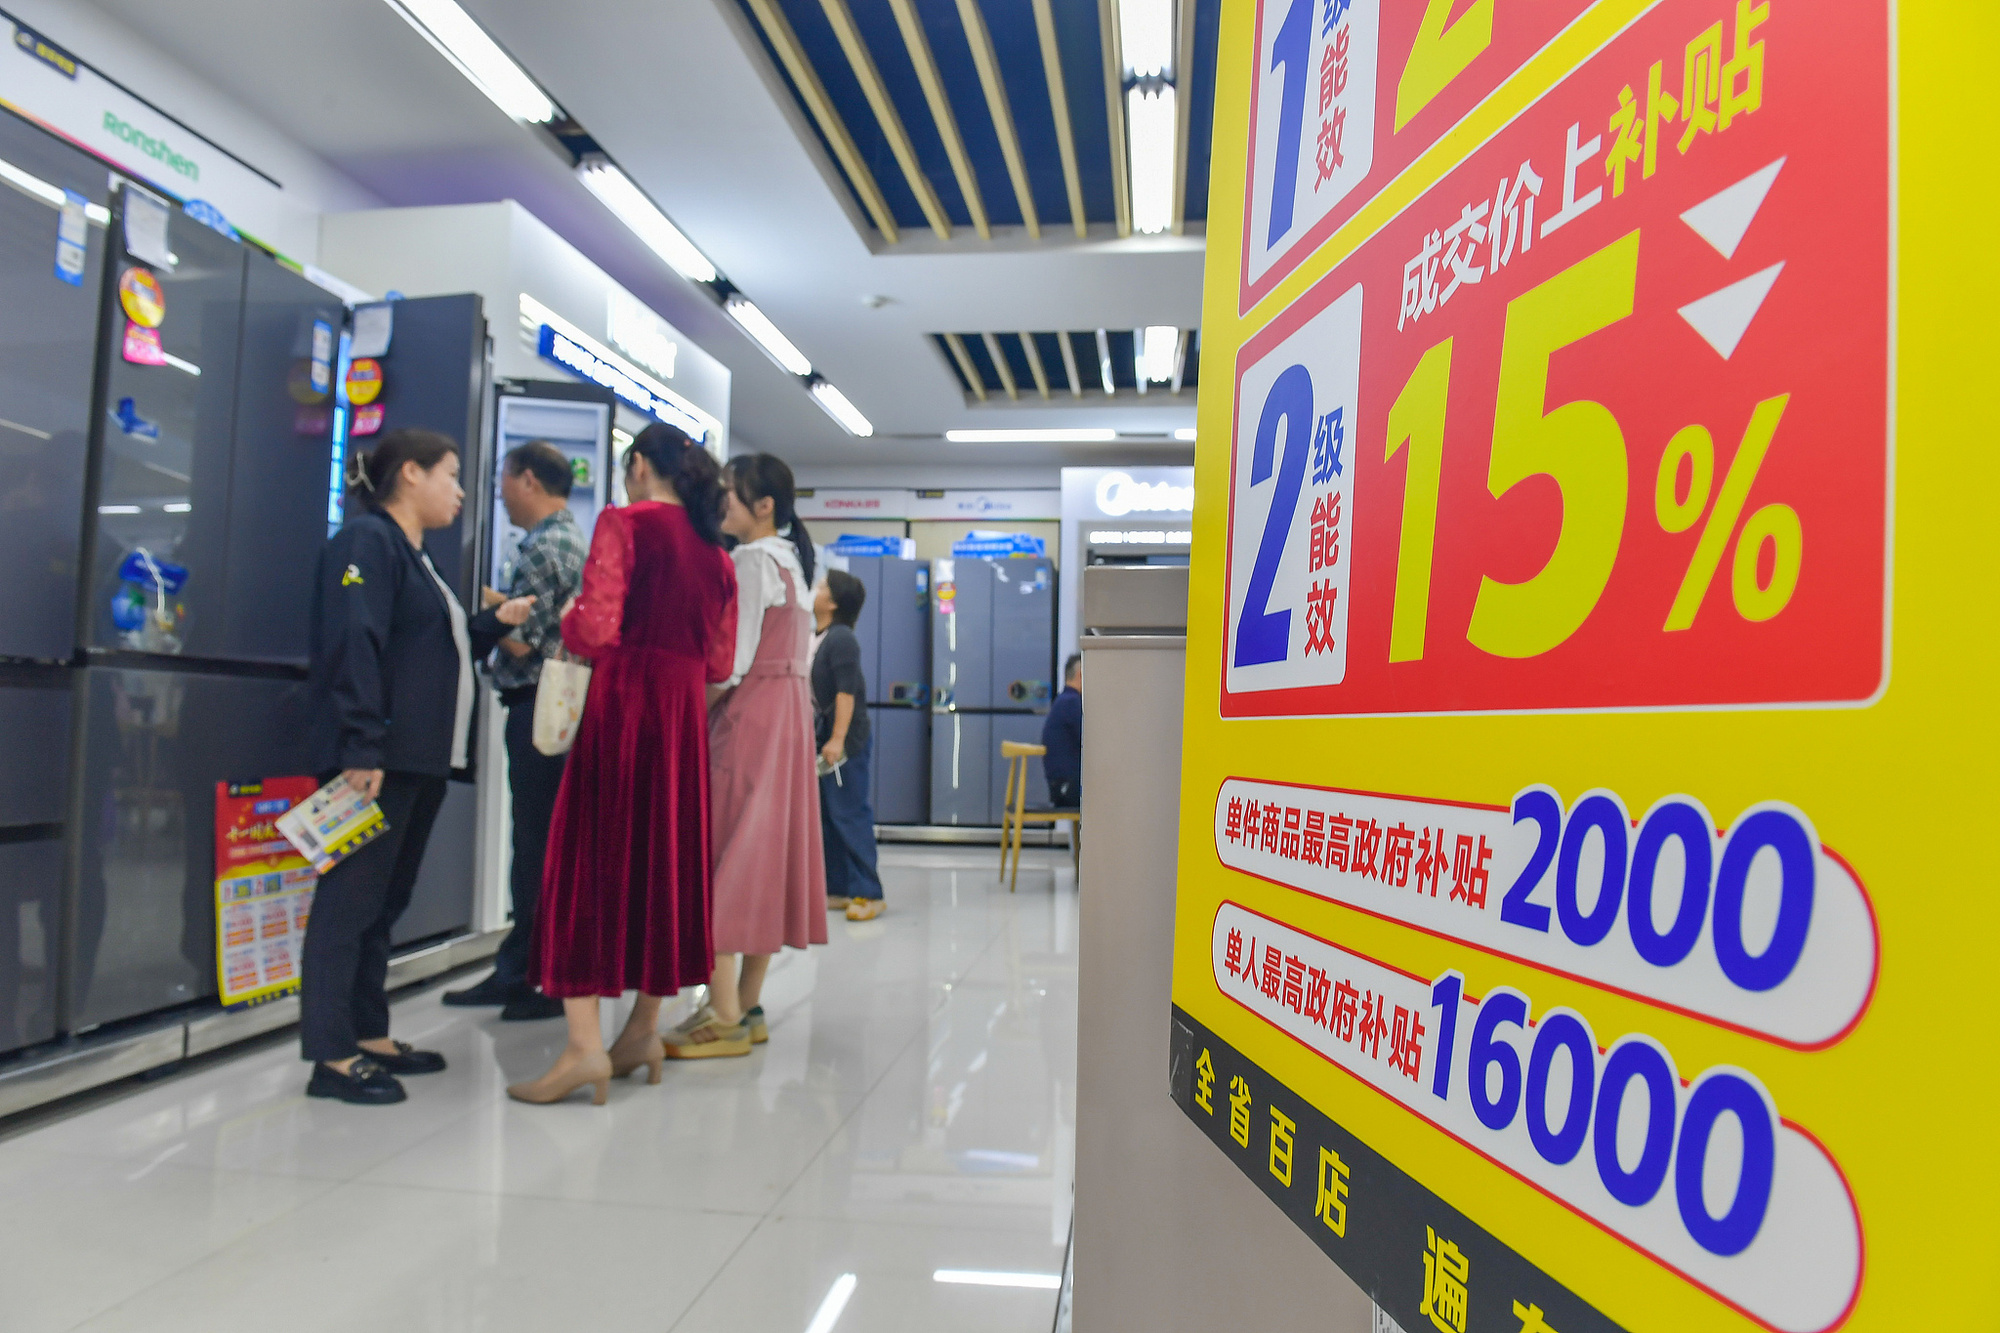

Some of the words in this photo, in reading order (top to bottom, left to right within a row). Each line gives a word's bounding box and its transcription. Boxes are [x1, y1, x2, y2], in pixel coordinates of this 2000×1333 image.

[1398, 0, 1770, 332] 成交价上补贴
[1384, 228, 1803, 664] 15%
[1225, 796, 1493, 910] 单件商品最高政府补贴
[1500, 790, 1815, 992] 2000
[1194, 1047, 1350, 1239] 全省百店
[1225, 927, 1426, 1083] 单人最高政府补贴
[1431, 974, 1775, 1258] 16000
